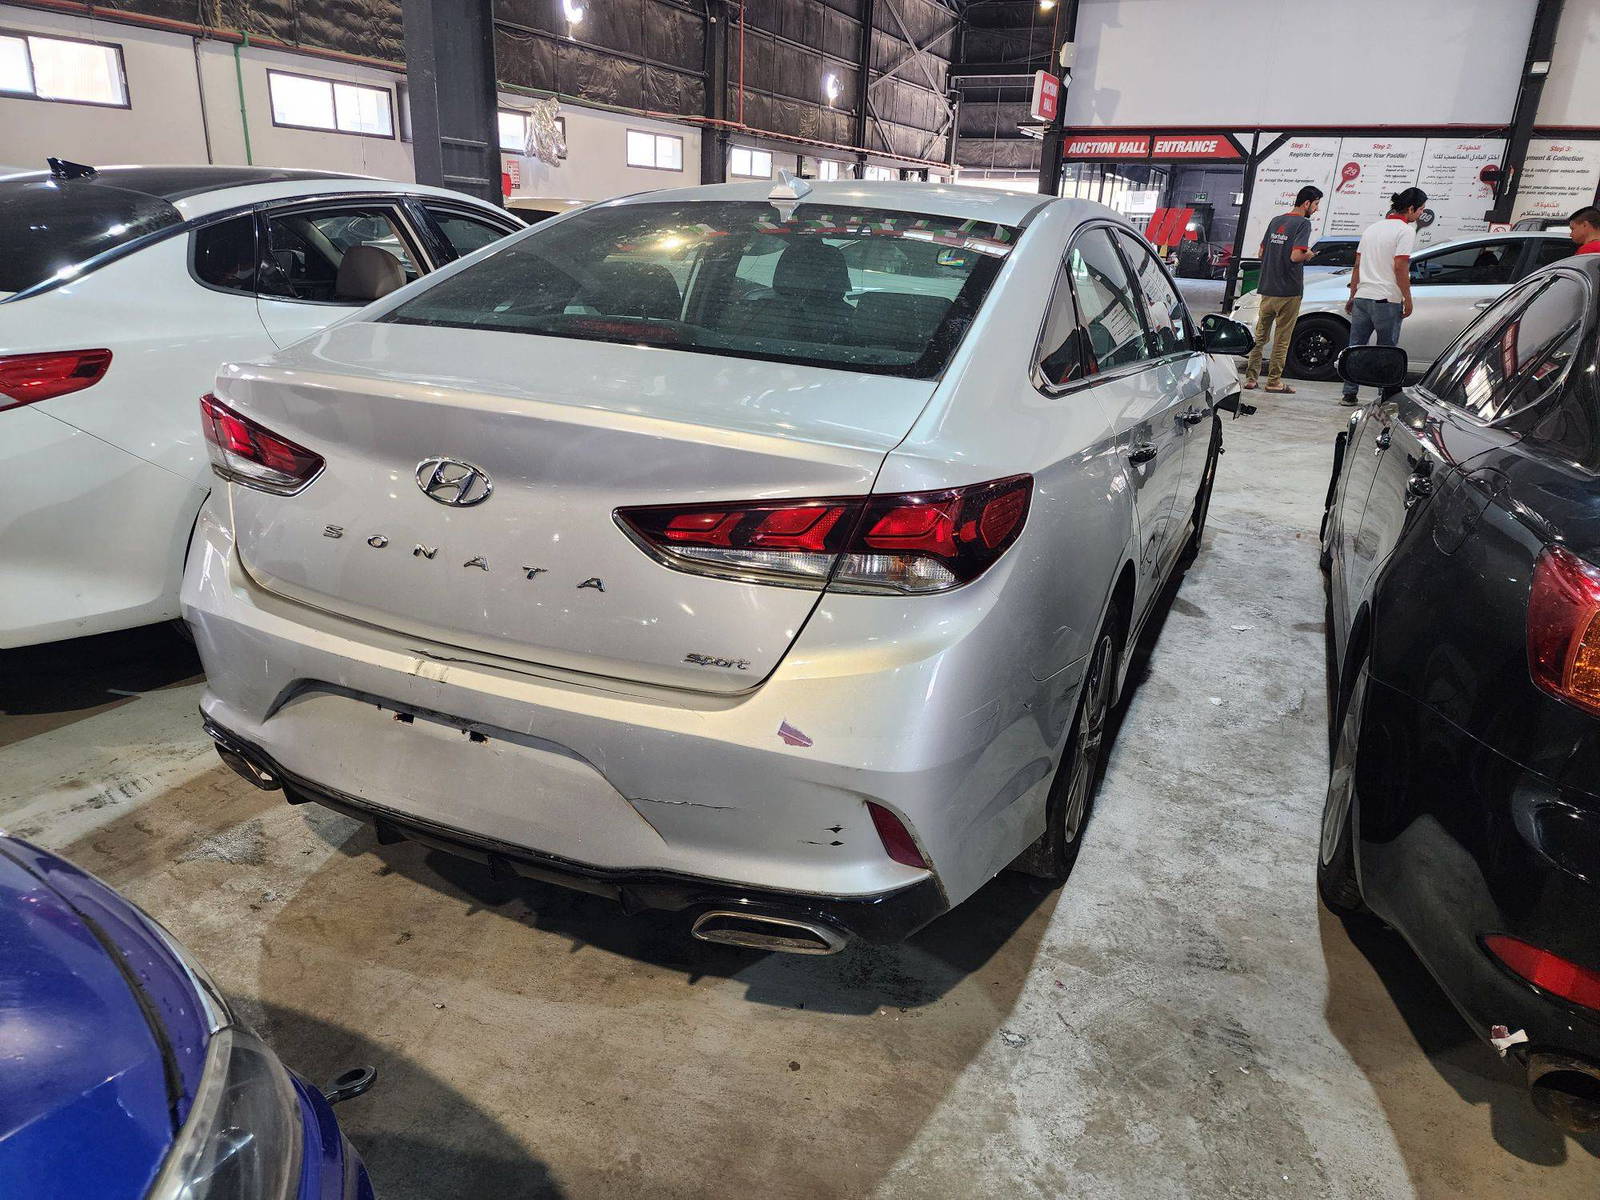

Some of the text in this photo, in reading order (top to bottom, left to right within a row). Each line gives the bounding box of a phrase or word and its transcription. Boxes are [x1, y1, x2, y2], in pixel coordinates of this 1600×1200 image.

[1042, 80, 1057, 97] AUCTION
[1043, 98, 1053, 112] HALL
[1068, 142, 1147, 154] AUCTION HALL
[1154, 140, 1218, 153] ENTRANCE
[1344, 167, 1358, 175] 29
[322, 523, 606, 592] SONATA
[684, 652, 751, 670] Sport
